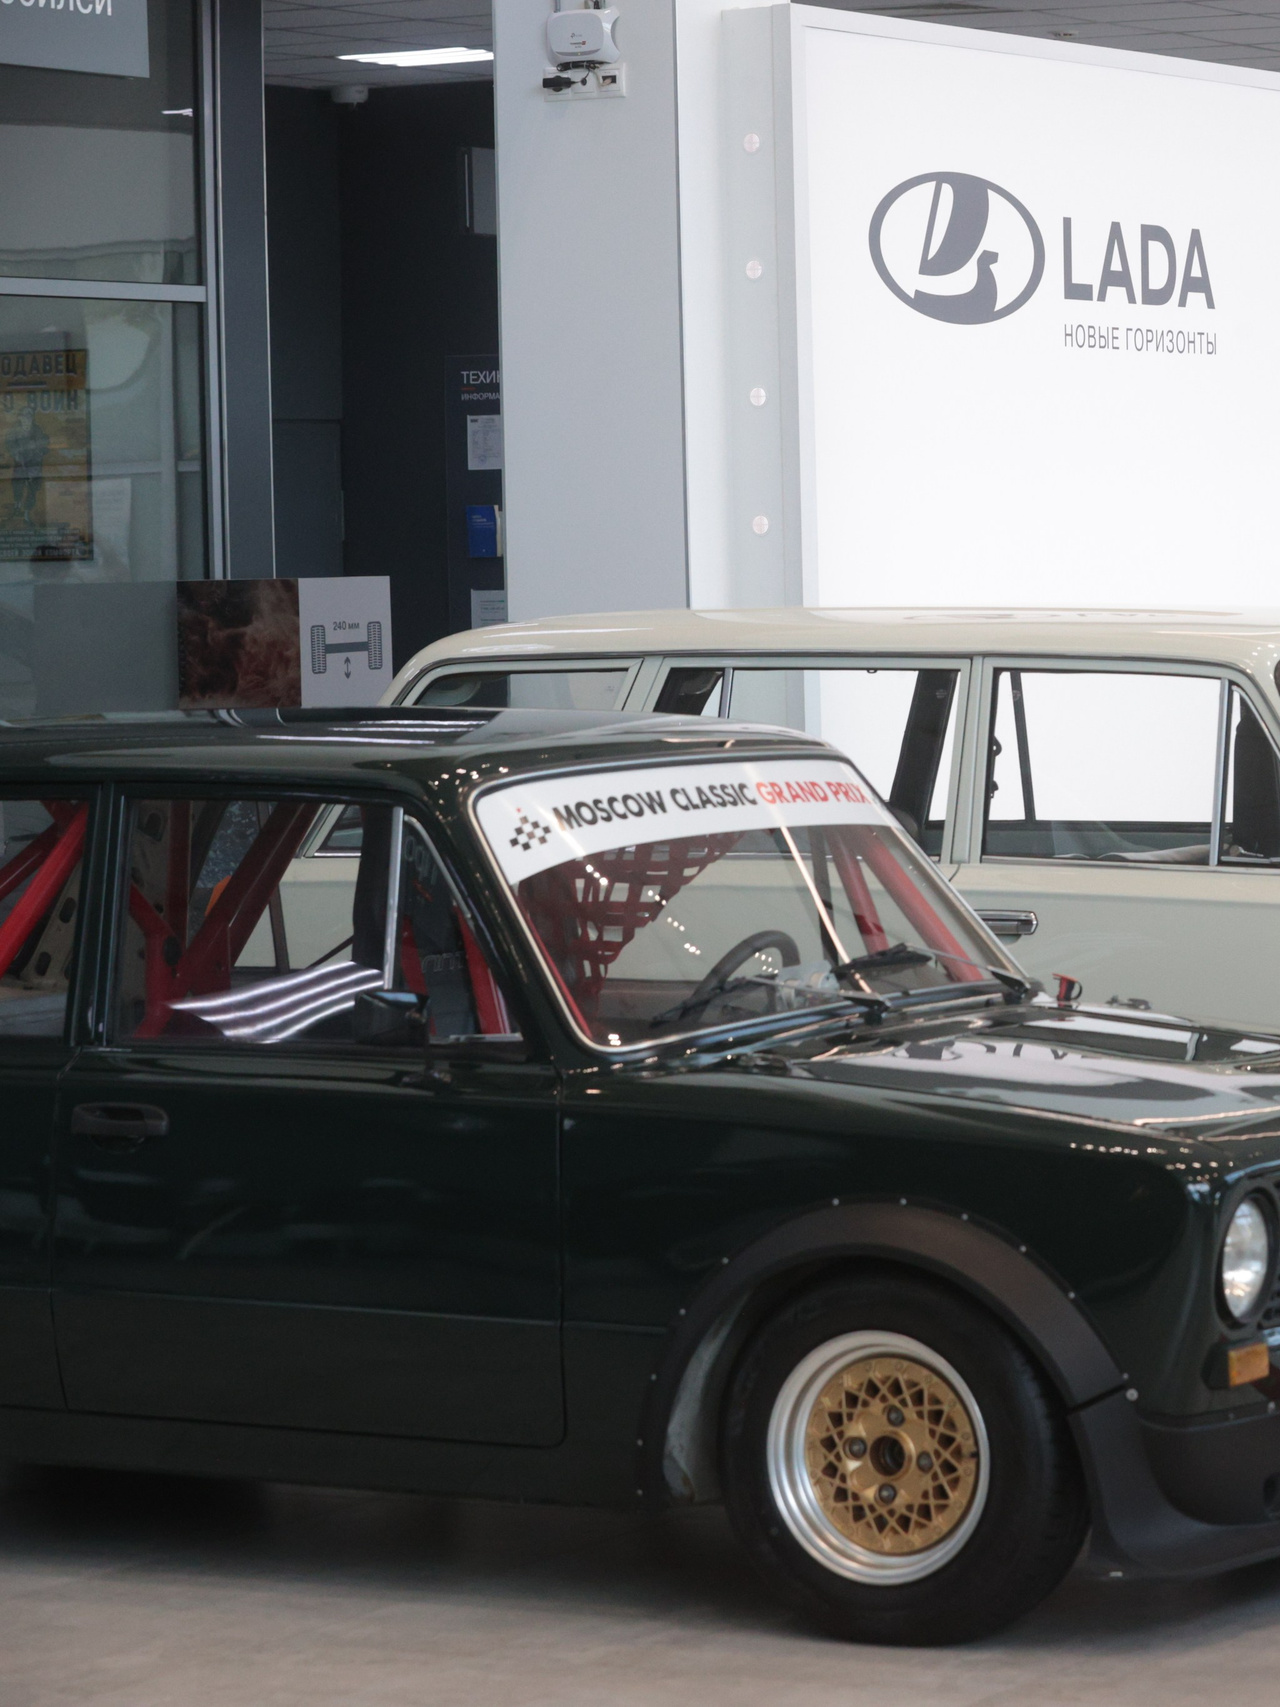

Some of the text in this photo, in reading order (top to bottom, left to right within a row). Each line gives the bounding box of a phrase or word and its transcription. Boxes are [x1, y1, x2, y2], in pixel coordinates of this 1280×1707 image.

[1062, 216, 1216, 310] LADA
[1064, 323, 1217, 355] НОВЫЕ ГОРИЗОНТЫ
[332, 620, 347, 631] 240
[552, 781, 872, 832] MOSCOW CLASSIC GRAND PRIX
